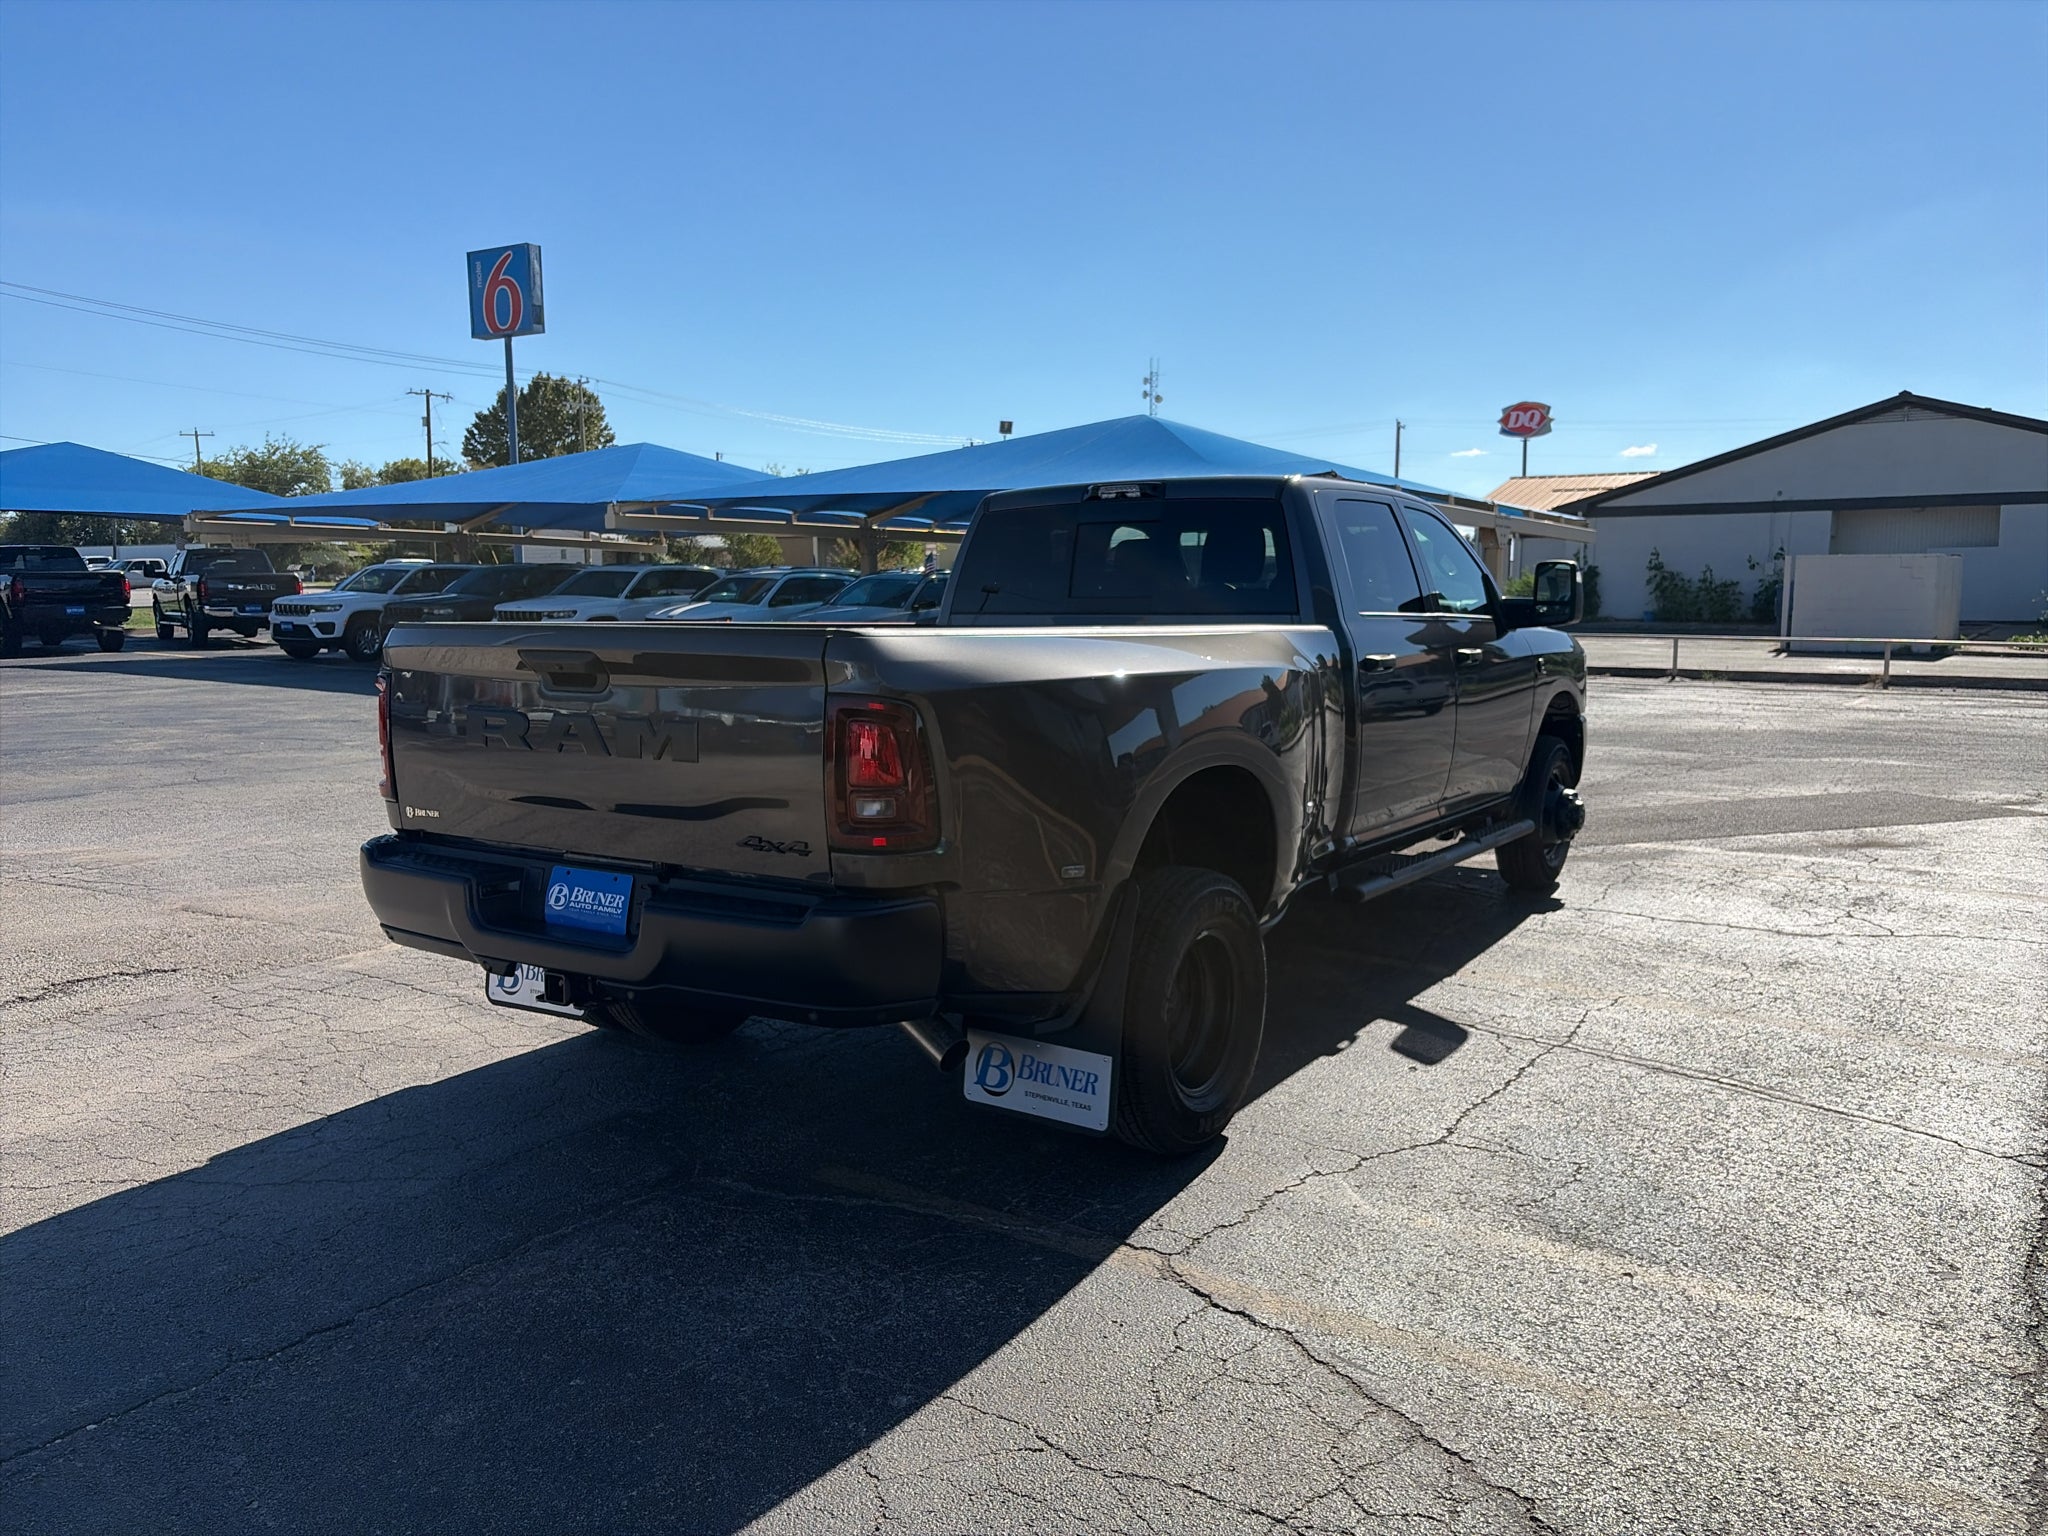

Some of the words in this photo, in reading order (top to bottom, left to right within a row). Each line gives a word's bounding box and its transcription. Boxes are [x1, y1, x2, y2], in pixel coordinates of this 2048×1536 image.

[483, 251, 523, 334] 6
[1507, 409, 1541, 429] DQ
[464, 704, 700, 763] RAM
[736, 835, 813, 857] 4x4
[569, 901, 592, 910] AUTO
[593, 904, 623, 914] FAMILY
[570, 887, 625, 908] BRUNER
[1017, 1054, 1099, 1096] BRUNER
[1024, 1091, 1070, 1107] STEPHENVILLE,
[1071, 1100, 1092, 1111] TEXAS
